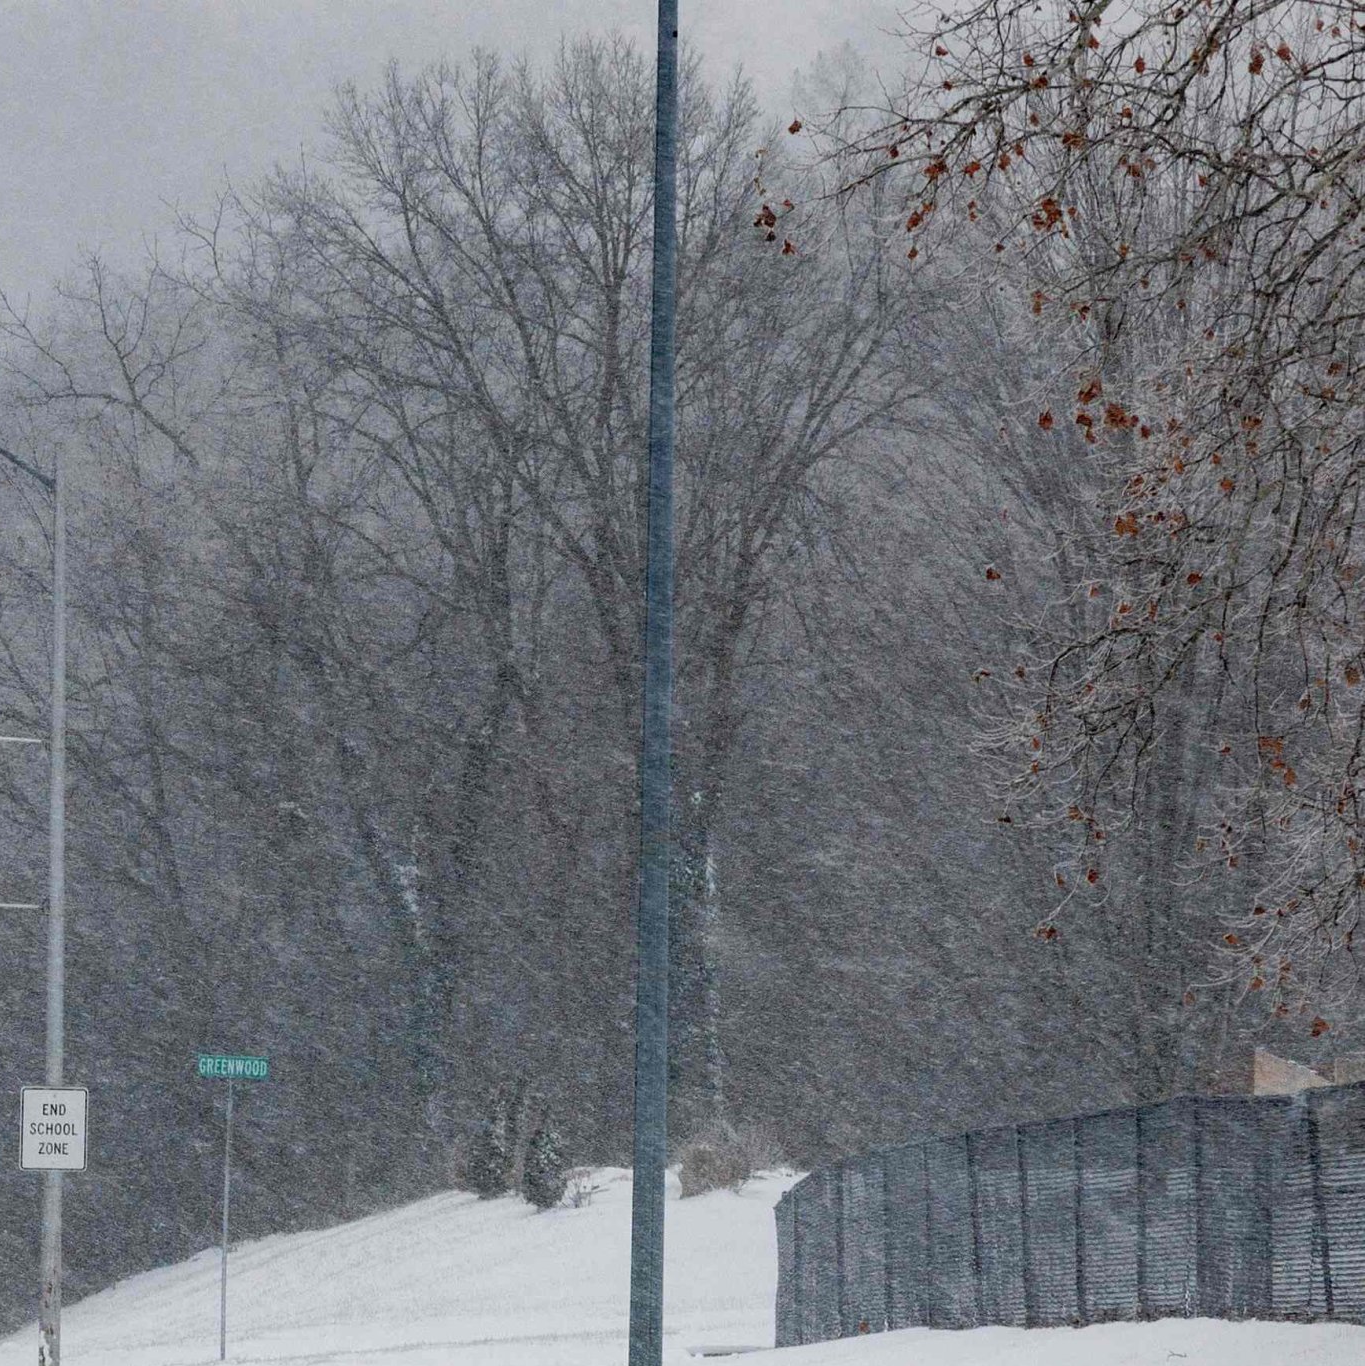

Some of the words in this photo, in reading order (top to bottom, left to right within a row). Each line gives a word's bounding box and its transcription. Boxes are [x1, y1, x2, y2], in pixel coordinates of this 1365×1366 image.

[199, 1058, 267, 1076] GREENWOOD
[42, 1103, 67, 1116] END
[29, 1122, 78, 1136] SCHOOL
[38, 1142, 69, 1155] ZONE
